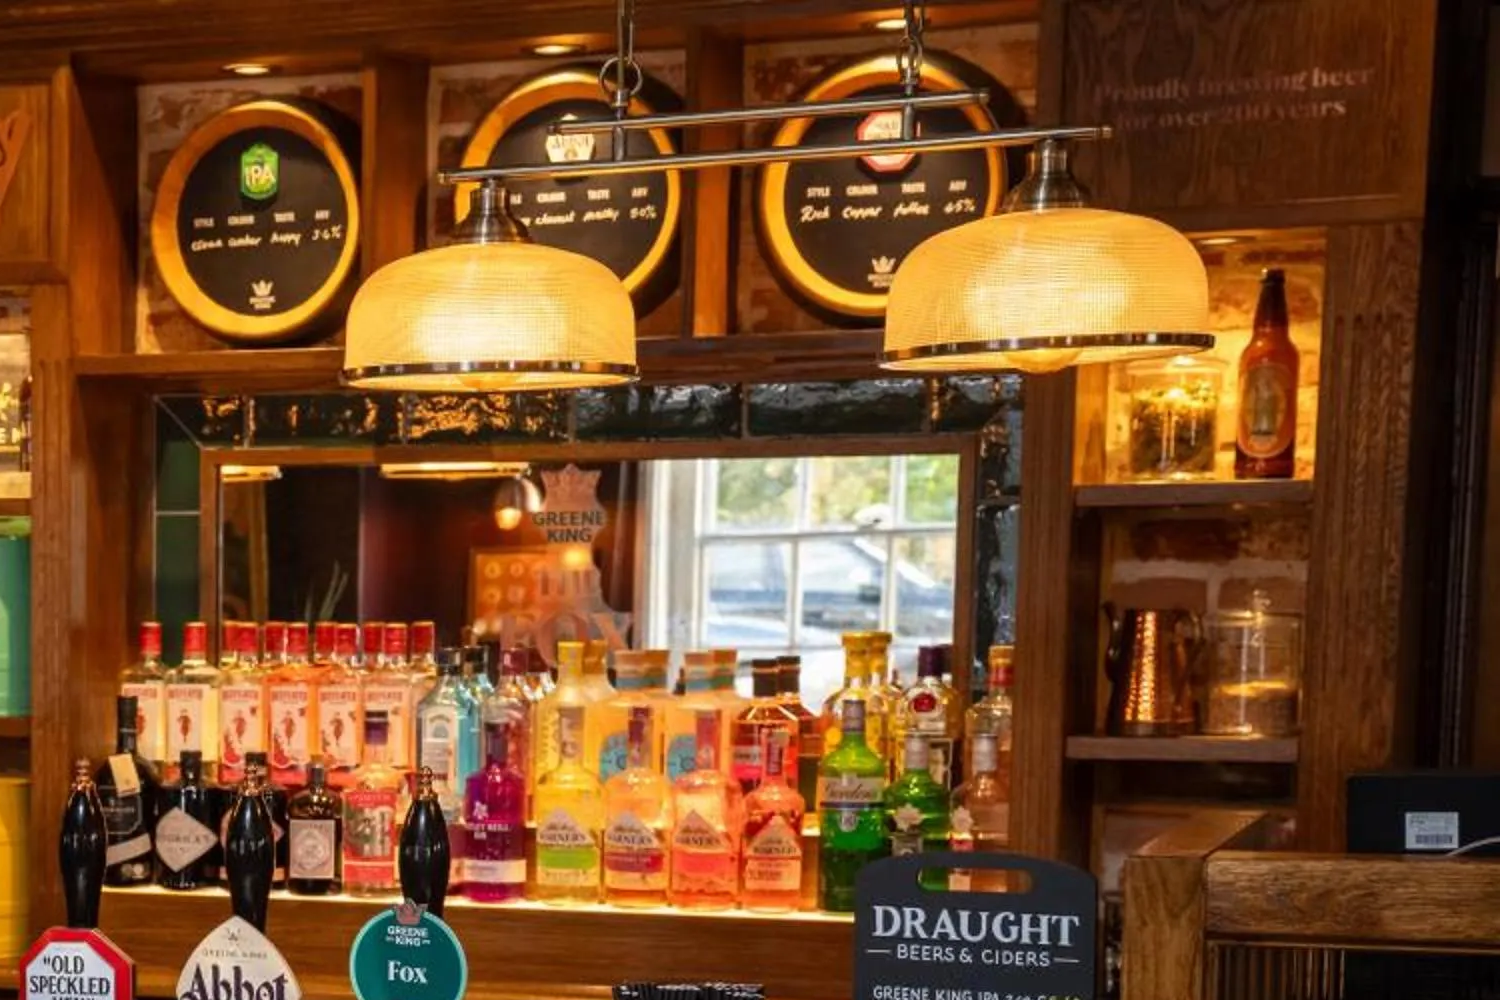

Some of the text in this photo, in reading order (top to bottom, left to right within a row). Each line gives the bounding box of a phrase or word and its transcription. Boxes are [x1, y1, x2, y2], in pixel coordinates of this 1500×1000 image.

[1311, 67, 1373, 88] beer
[1159, 107, 1213, 127] over
[1269, 100, 1347, 124] years
[244, 164, 277, 187] IPA
[533, 510, 606, 526] GREENE
[547, 528, 592, 543] KING
[387, 925, 429, 938] GREENE
[871, 905, 1081, 947] DRAUGHT
[395, 936, 421, 947] KING
[43, 955, 85, 975] "OLD
[897, 943, 1051, 967] BEERS & CIDERS
[387, 959, 428, 984] Fox
[29, 975, 111, 996] SPECKLED
